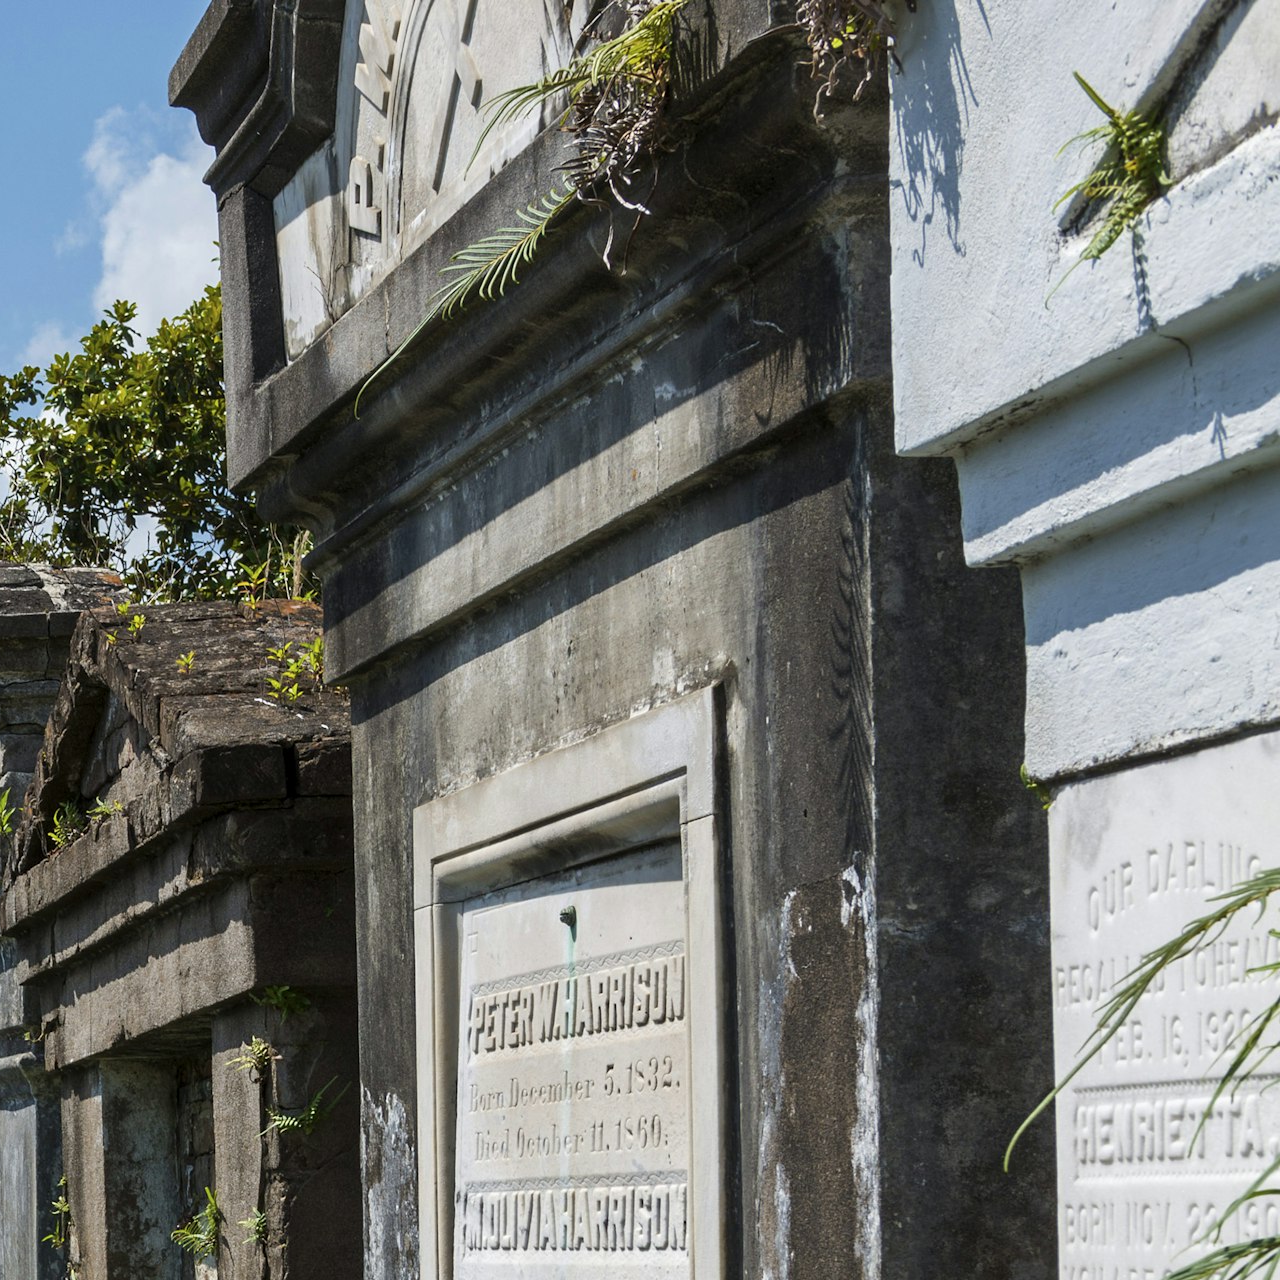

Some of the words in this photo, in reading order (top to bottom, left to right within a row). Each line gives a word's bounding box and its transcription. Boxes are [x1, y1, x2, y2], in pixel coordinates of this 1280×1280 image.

[1087, 858, 1135, 934] OUR
[472, 988, 535, 1055] PETER
[561, 955, 685, 1039] HARRISON
[469, 1083, 505, 1113] Born
[509, 1070, 595, 1110] December
[474, 1128, 510, 1161] Died
[516, 1122, 584, 1158] October
[489, 1189, 557, 1252] OLIVIA
[558, 1182, 688, 1252] HARRISON
[1064, 1202, 1114, 1246] BORN
